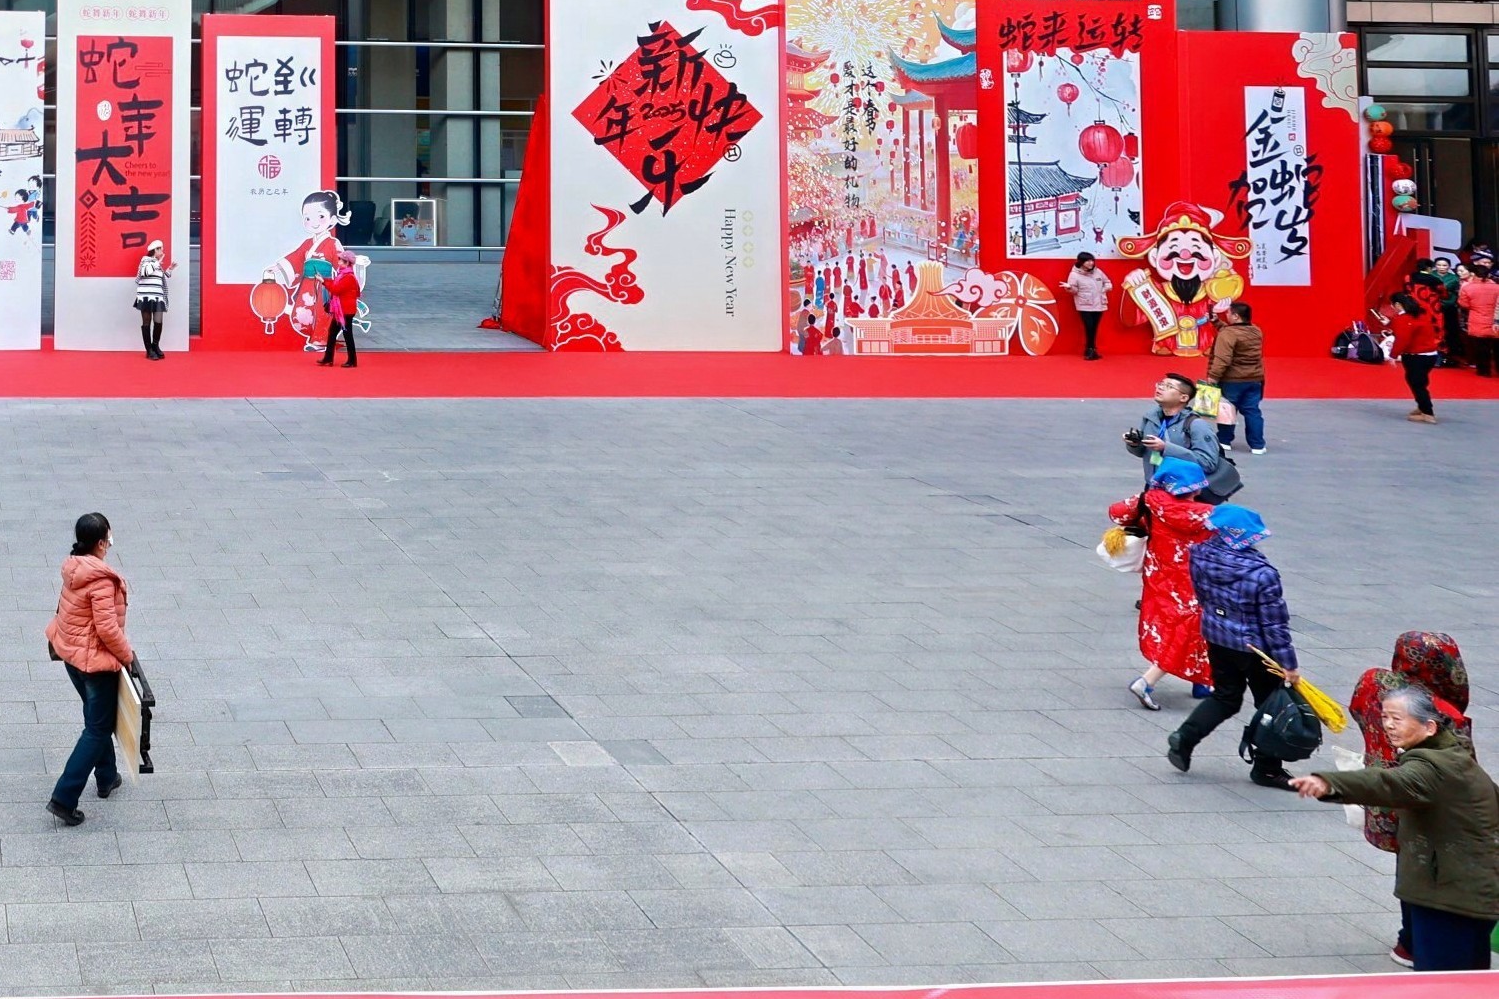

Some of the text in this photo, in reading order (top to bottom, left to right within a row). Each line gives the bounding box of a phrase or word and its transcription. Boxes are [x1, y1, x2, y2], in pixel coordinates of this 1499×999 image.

[998, 11, 1144, 51] 蛇来运转
[124, 161, 157, 170] Cheers to
[124, 170, 136, 178] the
[720, 208, 737, 317] Happy New Year
